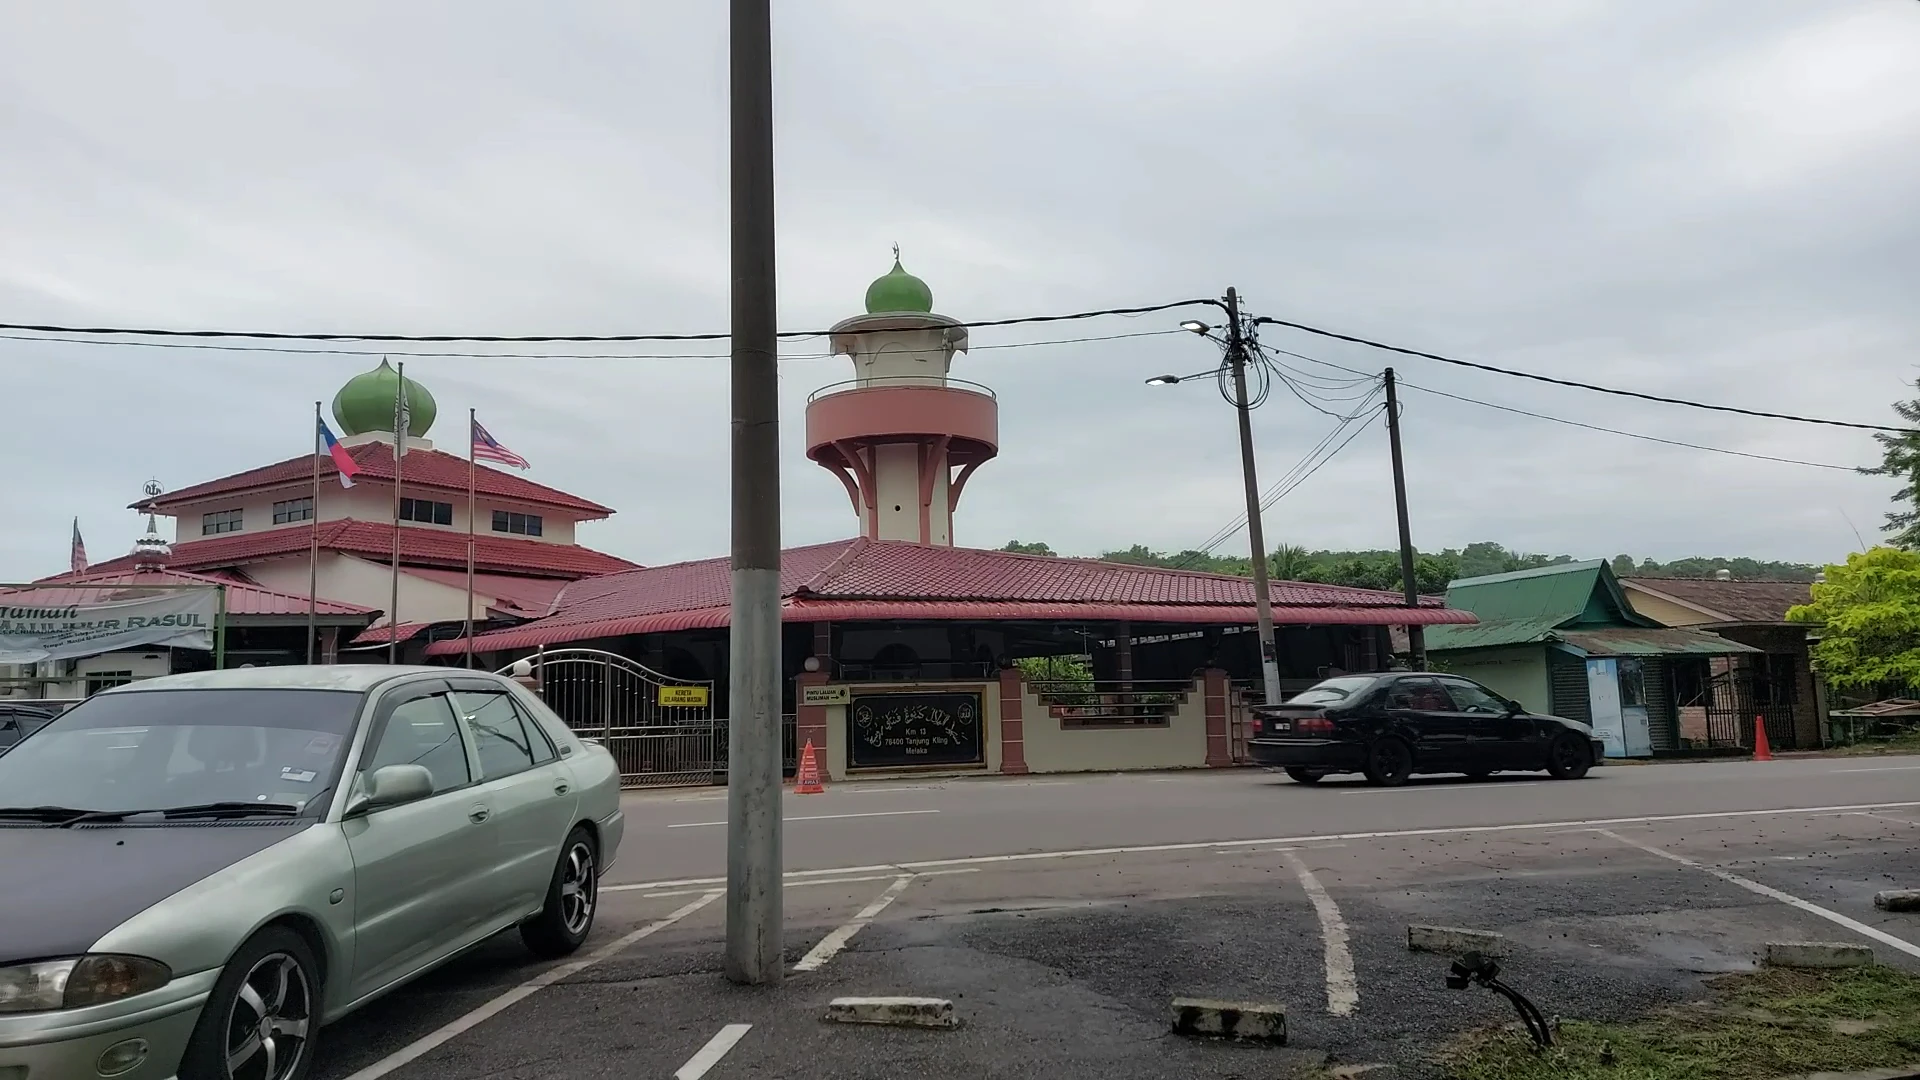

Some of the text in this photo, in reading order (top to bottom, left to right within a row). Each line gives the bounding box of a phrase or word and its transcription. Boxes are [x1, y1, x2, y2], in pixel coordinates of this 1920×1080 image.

[127, 613, 207, 628] RASUL
[905, 727, 927, 736] Km 13
[905, 737, 930, 747] Tanjung
[931, 736, 949, 746] Kling
[905, 747, 928, 755] Melaka
